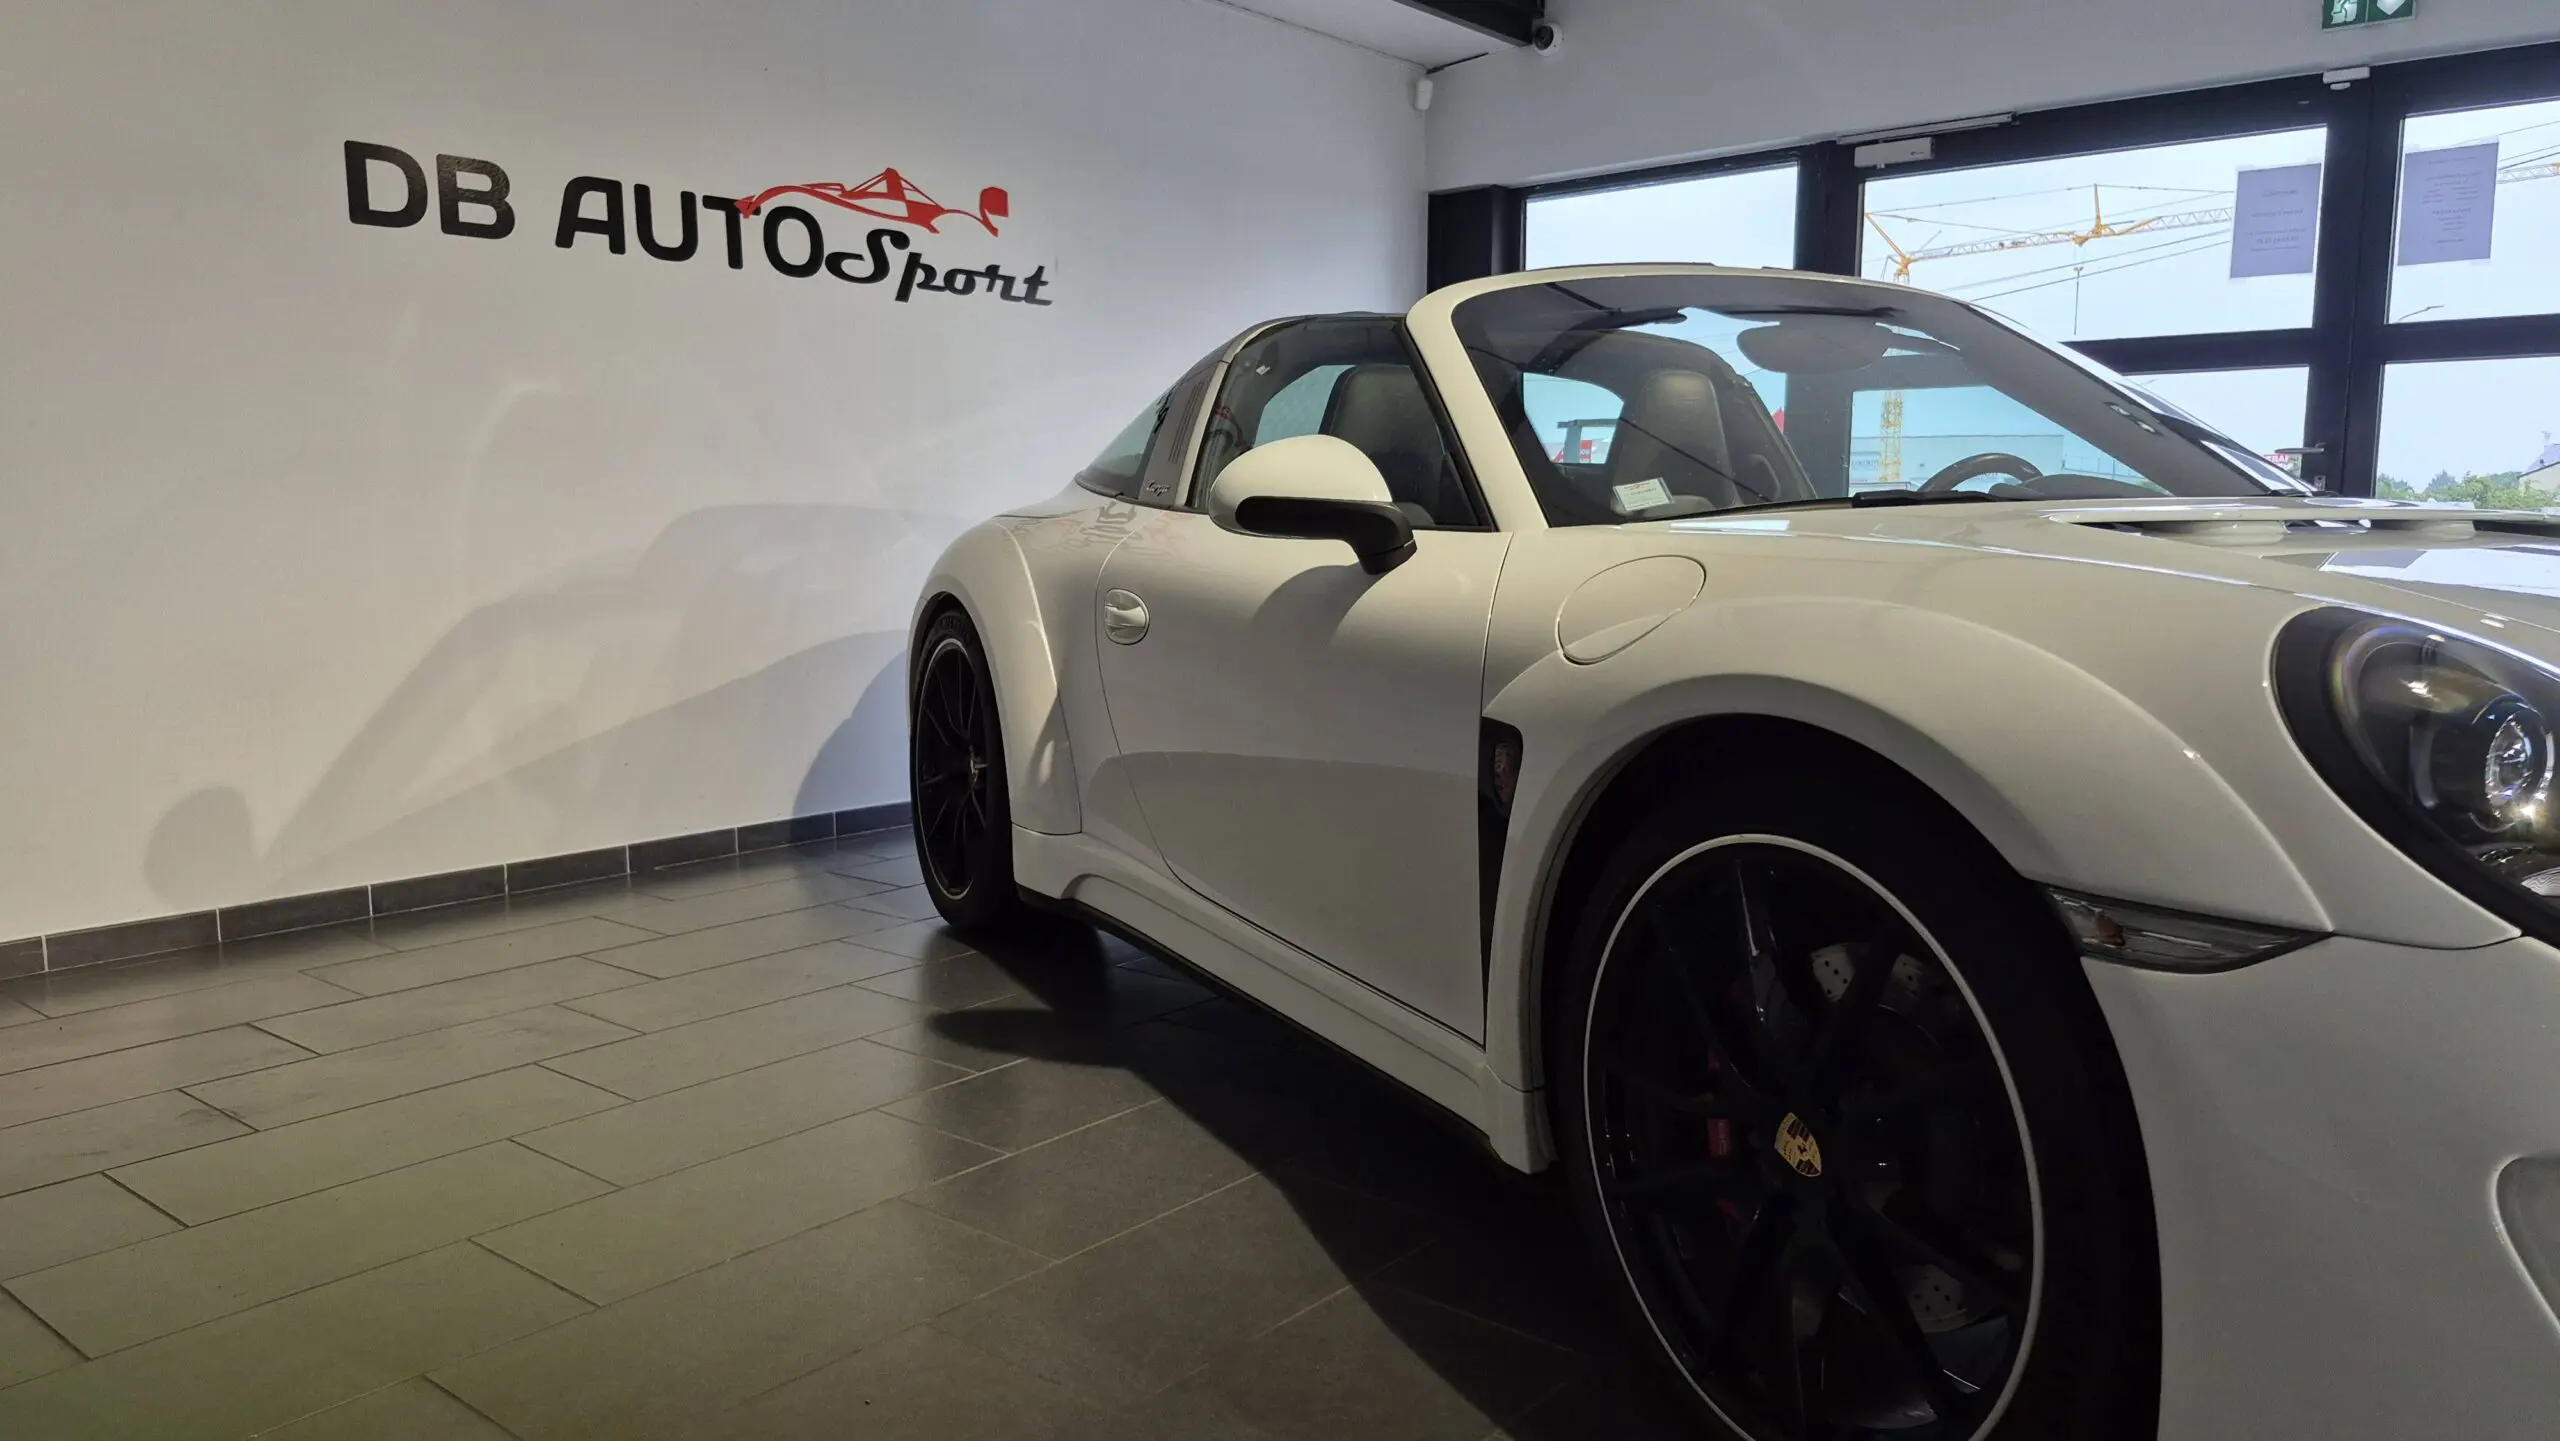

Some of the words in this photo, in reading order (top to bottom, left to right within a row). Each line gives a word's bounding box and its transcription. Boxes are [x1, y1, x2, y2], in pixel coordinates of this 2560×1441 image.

[343, 139, 516, 240] DB
[554, 175, 825, 279] AUTO
[824, 227, 1053, 306] Sport
